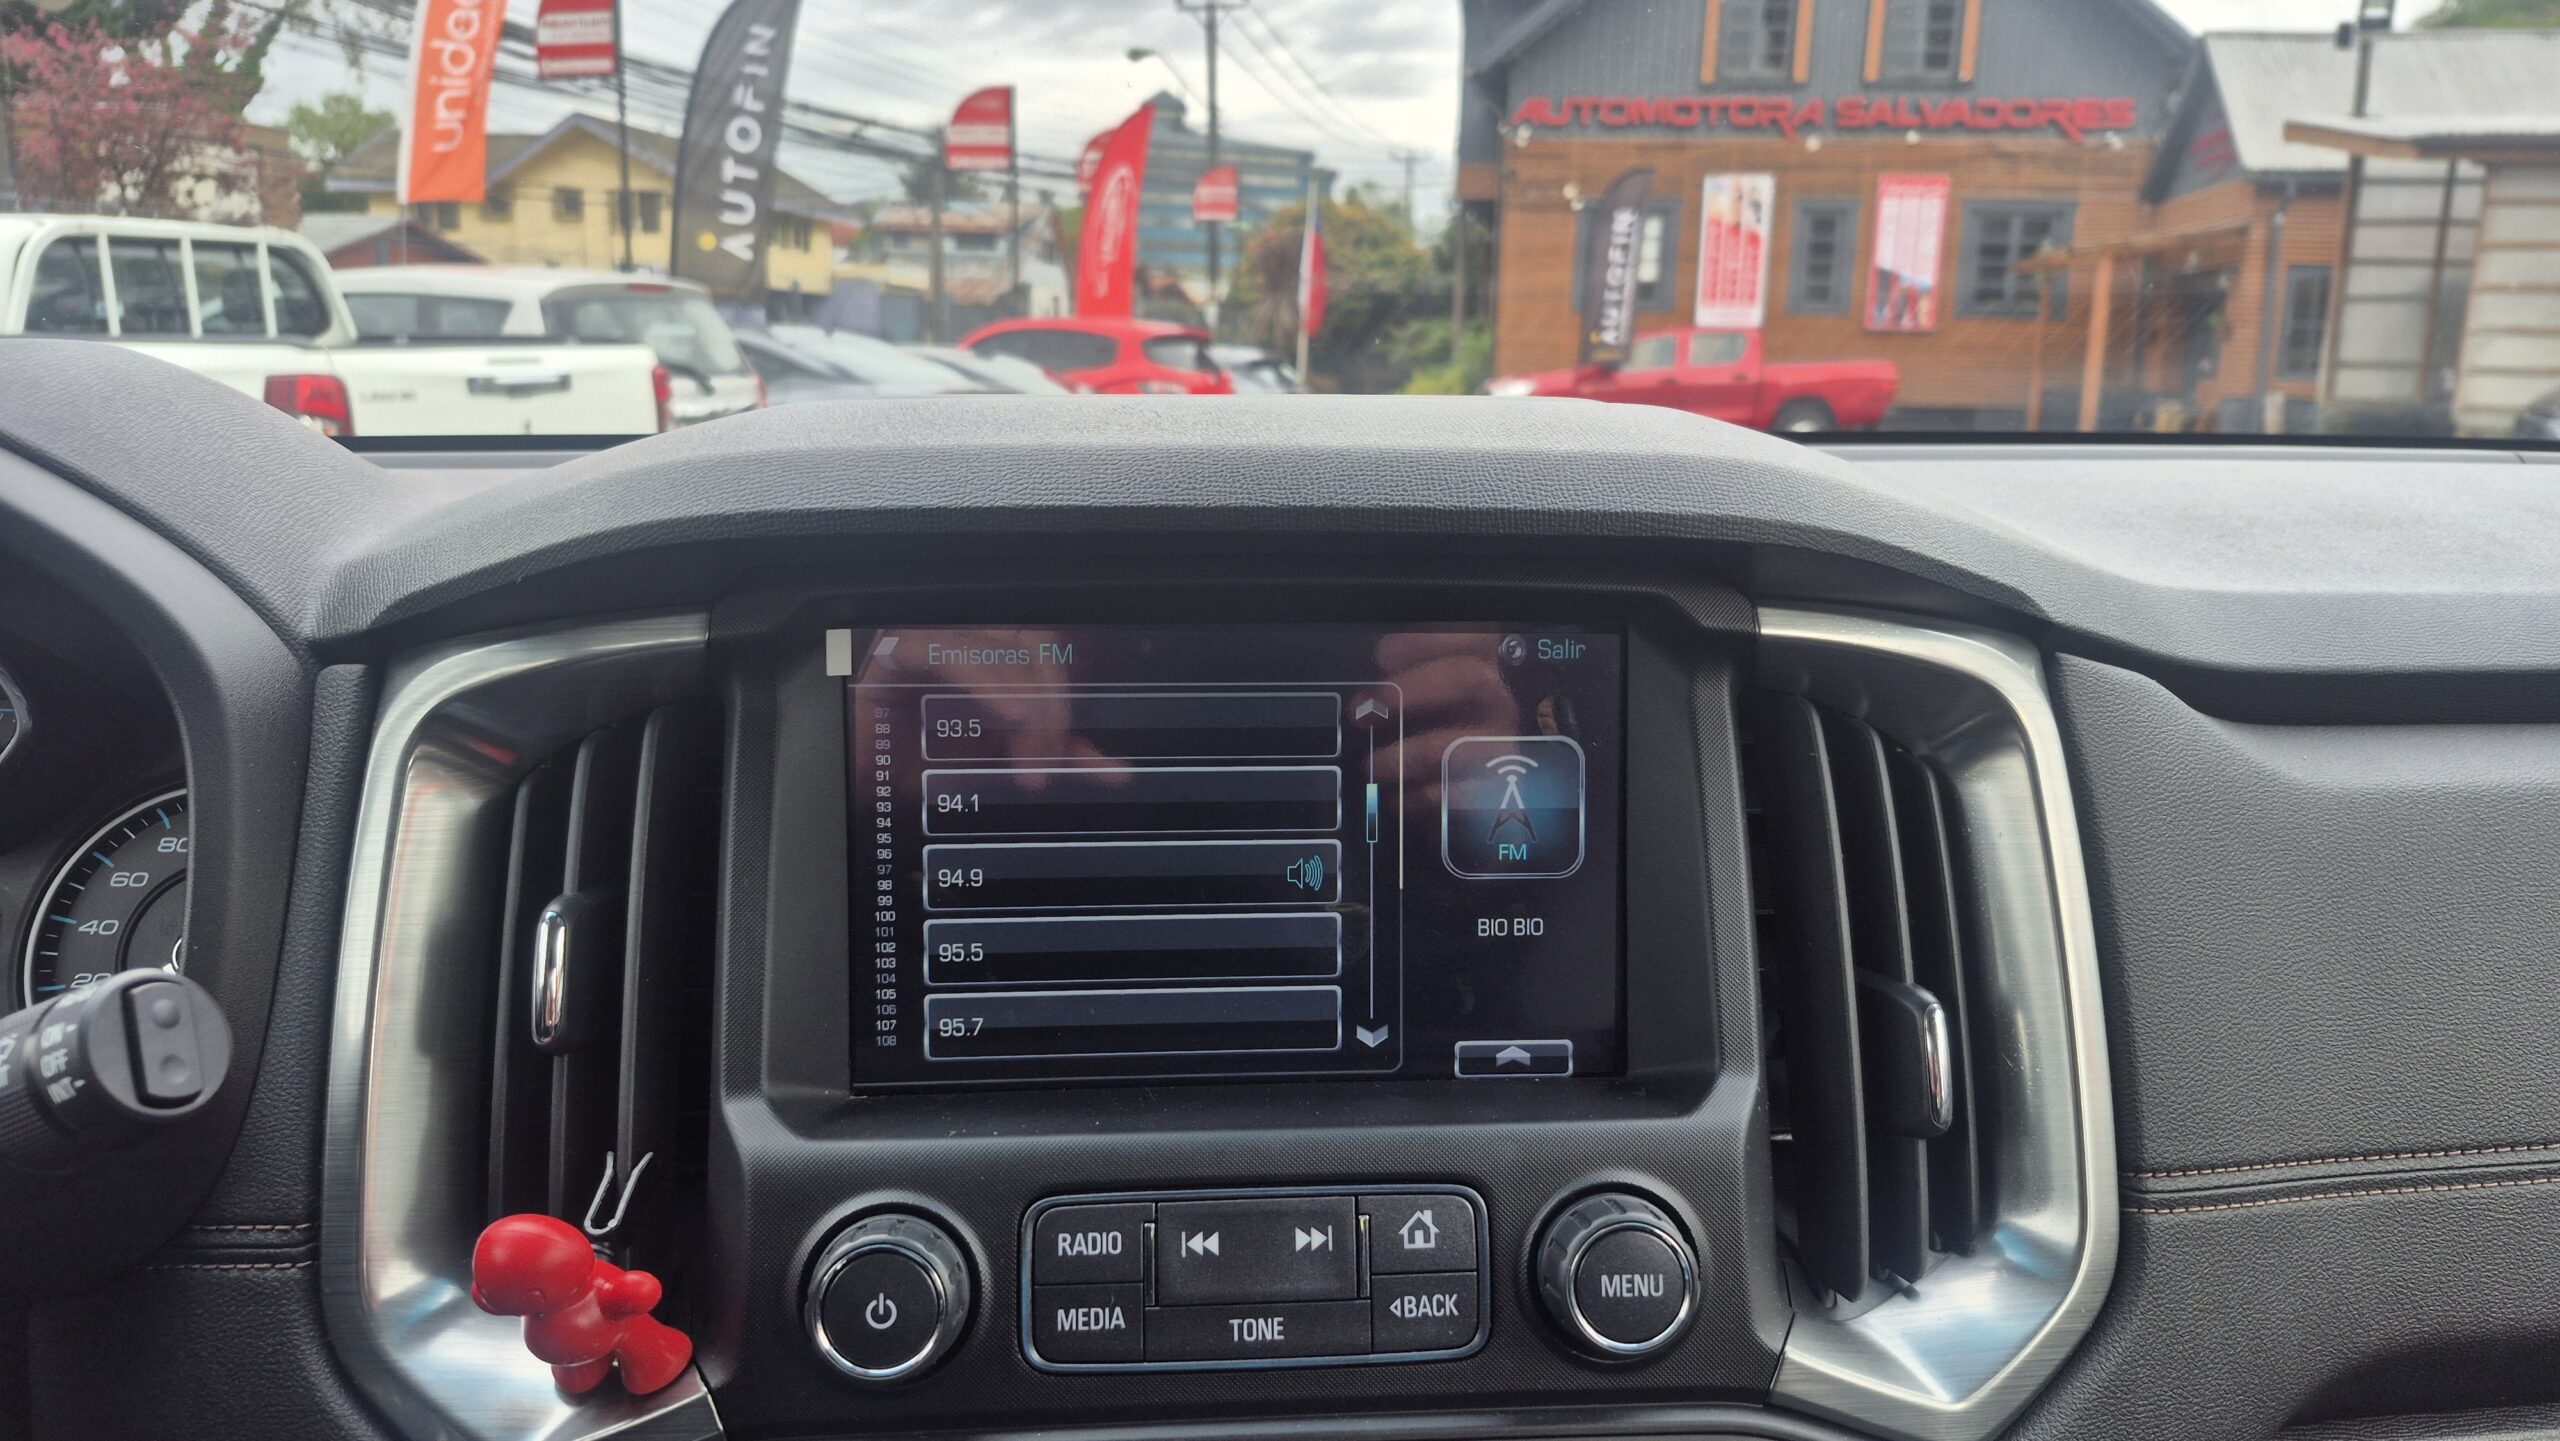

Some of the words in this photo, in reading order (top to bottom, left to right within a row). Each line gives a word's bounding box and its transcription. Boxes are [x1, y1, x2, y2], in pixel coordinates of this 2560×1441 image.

[428, 0, 483, 153] unida
[1512, 97, 1824, 139] AUTOMOTORA
[1834, 97, 2136, 144] SALVADORES
[718, 23, 777, 261] AUTOFIN
[928, 644, 1030, 665] Emisoras
[1039, 643, 1073, 665] FM
[1538, 638, 1586, 659] Salir
[875, 707, 890, 718] 87
[875, 723, 890, 734] 88
[937, 719, 981, 738] 93.5
[875, 739, 891, 750] 89
[875, 755, 891, 765] 90
[876, 770, 890, 781] 91
[876, 786, 891, 797] 92
[876, 802, 892, 812] 93
[937, 794, 979, 813] 94.1
[876, 817, 892, 828] 94
[877, 833, 892, 844] 95
[877, 848, 892, 859] 96
[1498, 843, 1527, 861] FM
[877, 864, 892, 875] 97
[110, 871, 150, 887] 60
[938, 868, 983, 887] 94.9
[877, 879, 893, 891] 98
[877, 895, 893, 906] 99
[875, 911, 896, 922] 100
[78, 919, 119, 935] 40
[875, 926, 895, 937] 101
[1478, 918, 1508, 937] BIO
[1513, 917, 1544, 936] BIO
[875, 942, 896, 953] 102
[939, 943, 984, 962] 95.5
[875, 957, 896, 968] 103
[875, 973, 896, 983] 104
[875, 988, 896, 999] 105
[875, 1004, 896, 1015] 106
[875, 1019, 897, 1030] 107
[939, 1017, 984, 1037] 95.7
[875, 1035, 896, 1046] 108
[41, 1048, 68, 1079] OFF
[1058, 1231, 1122, 1256] RADIO
[1600, 1273, 1664, 1298] MENU
[1404, 1293, 1459, 1318] BACK
[1057, 1306, 1126, 1331] MEDIA
[1229, 1317, 1285, 1342] TONE
